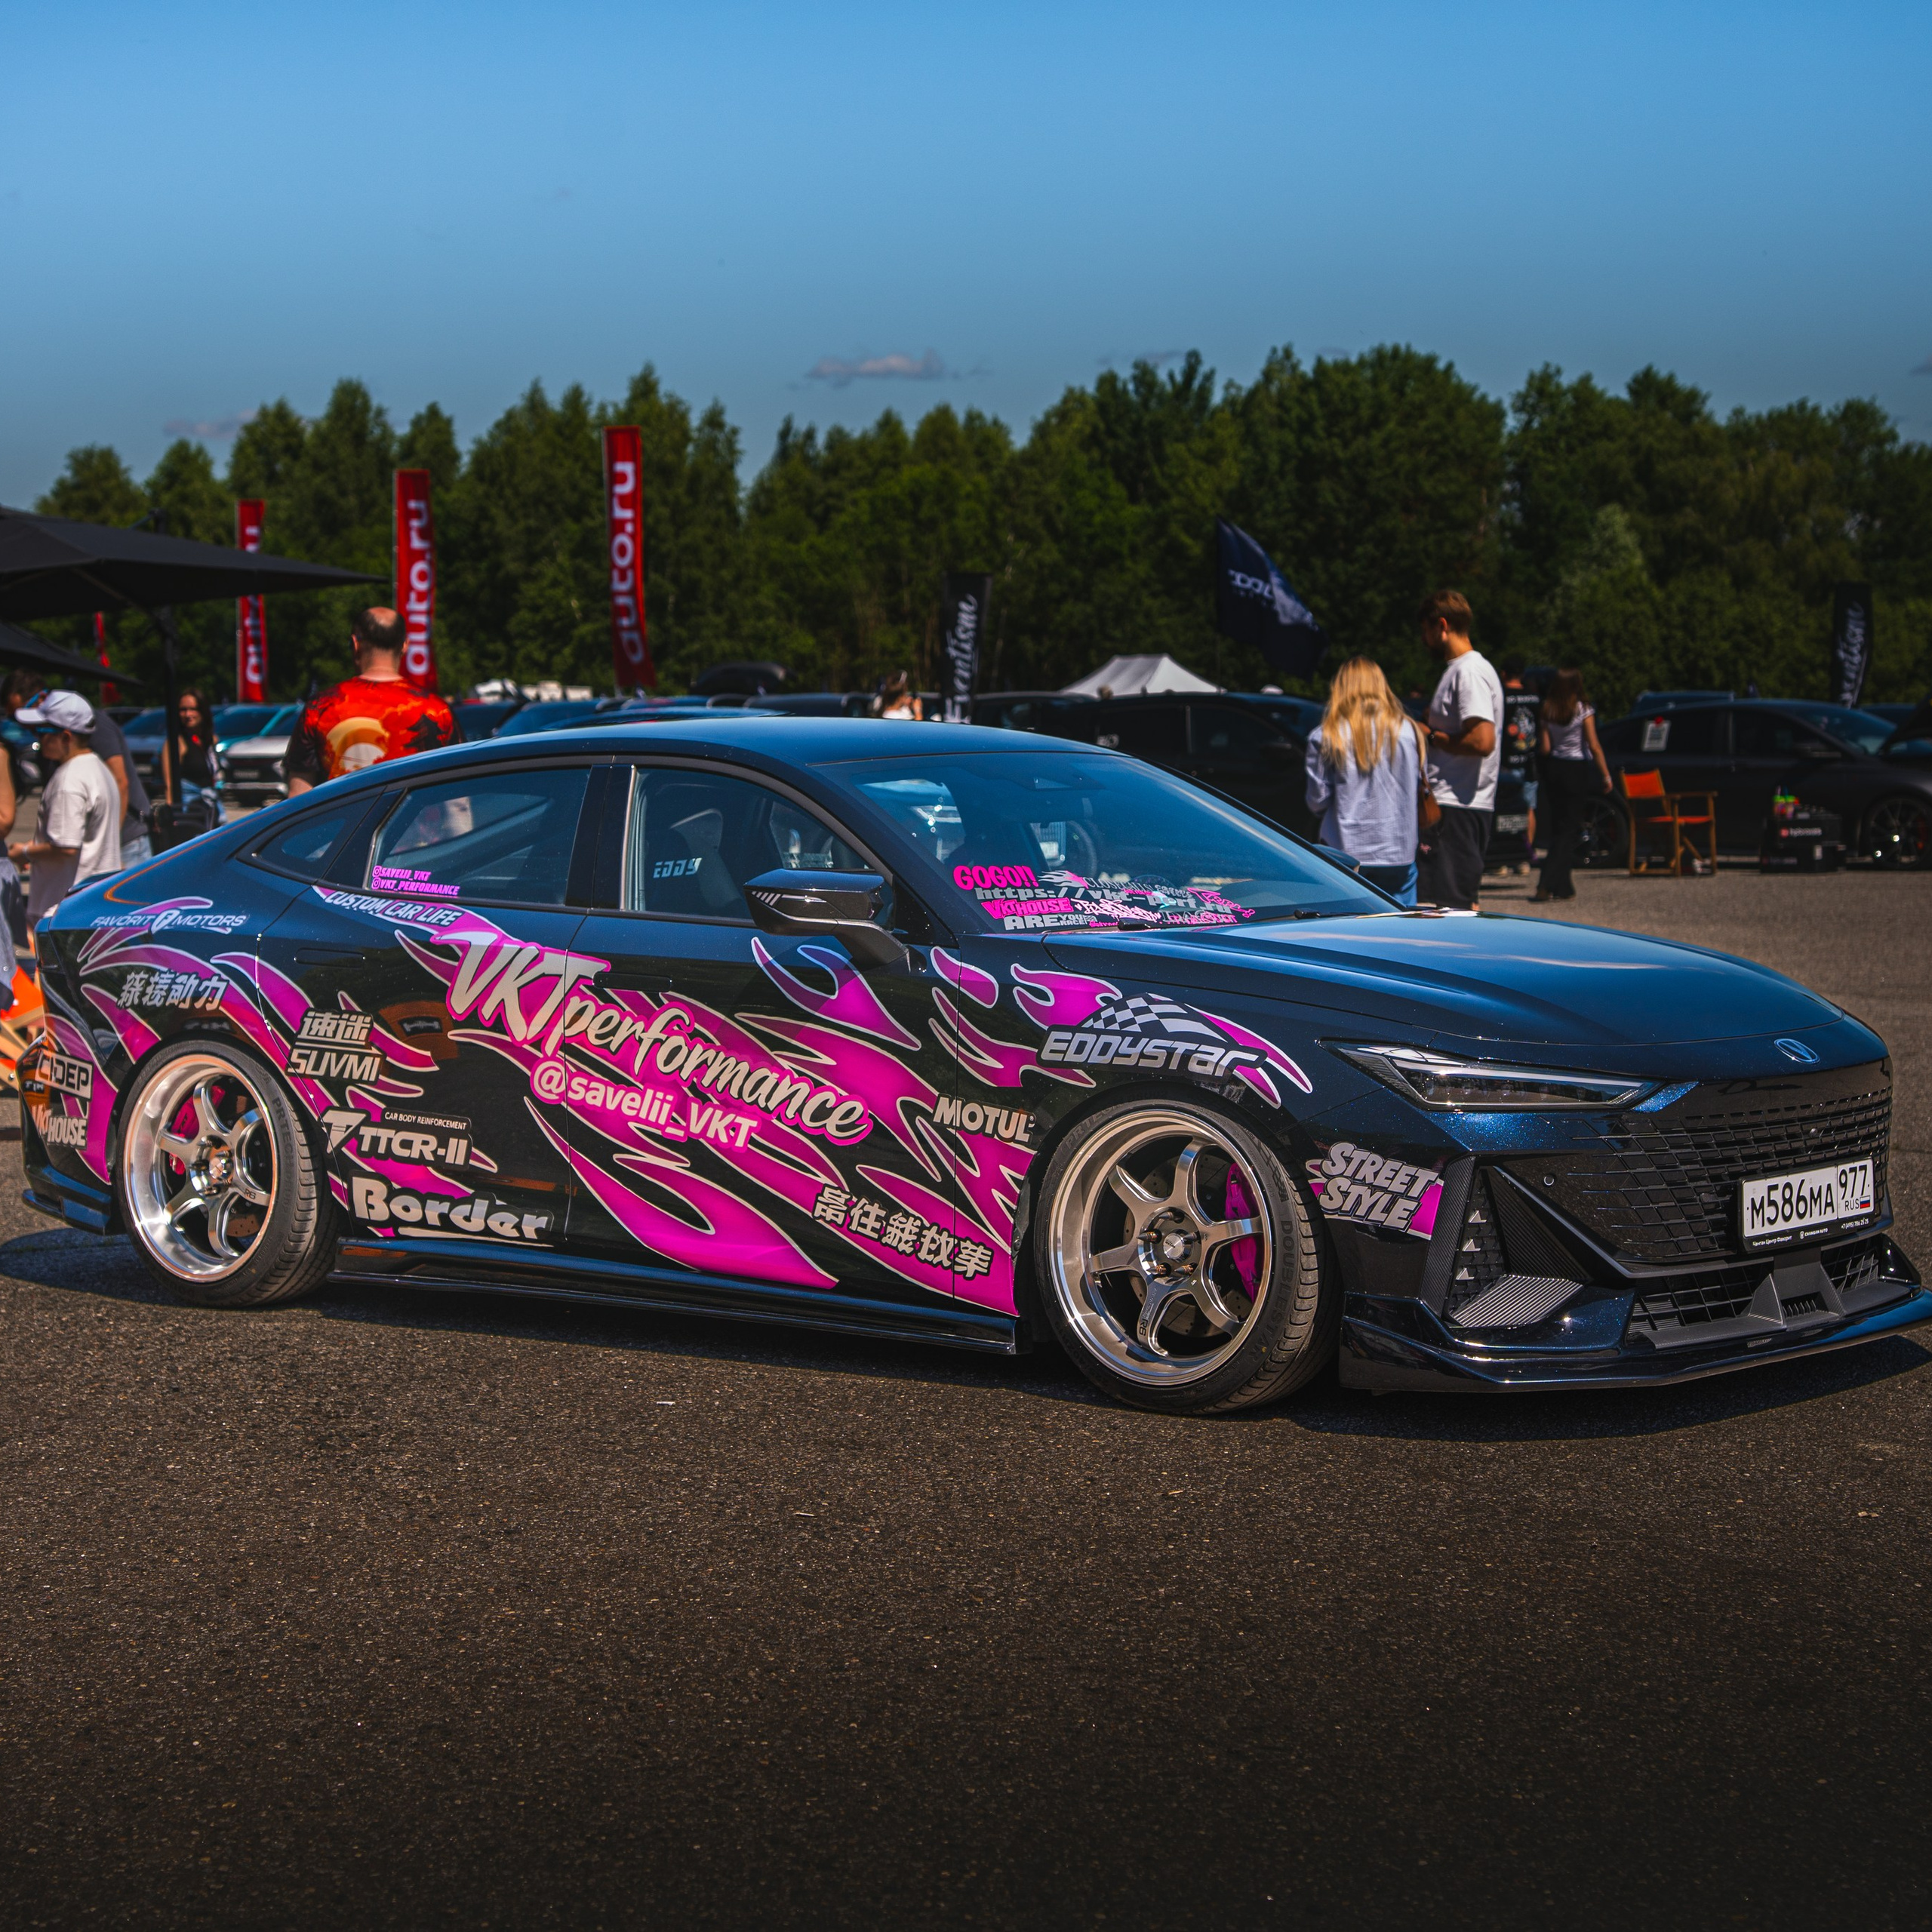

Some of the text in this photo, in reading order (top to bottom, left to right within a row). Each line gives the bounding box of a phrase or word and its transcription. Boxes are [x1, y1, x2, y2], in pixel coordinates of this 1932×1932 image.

[611, 461, 644, 663] auto.ru
[406, 500, 433, 675] auto.ru
[953, 866, 1039, 891] GOGO!!
[90, 915, 247, 928] FAVORIT MOTORS
[325, 891, 394, 914] CUSTOM
[384, 902, 423, 919] CAR
[288, 1048, 380, 1082] SUVMI
[384, 1112, 467, 1130] CAR BODY REINFORCEMENT
[534, 1061, 758, 1149] @savelii_VKT
[933, 1097, 1032, 1143] MOTUL
[1321, 1142, 1439, 1198] STREET
[1838, 1164, 1868, 1201] 977
[352, 1176, 549, 1239] Border
[1318, 1177, 1419, 1229] STYLE
[1844, 1198, 1860, 1211] RUS
